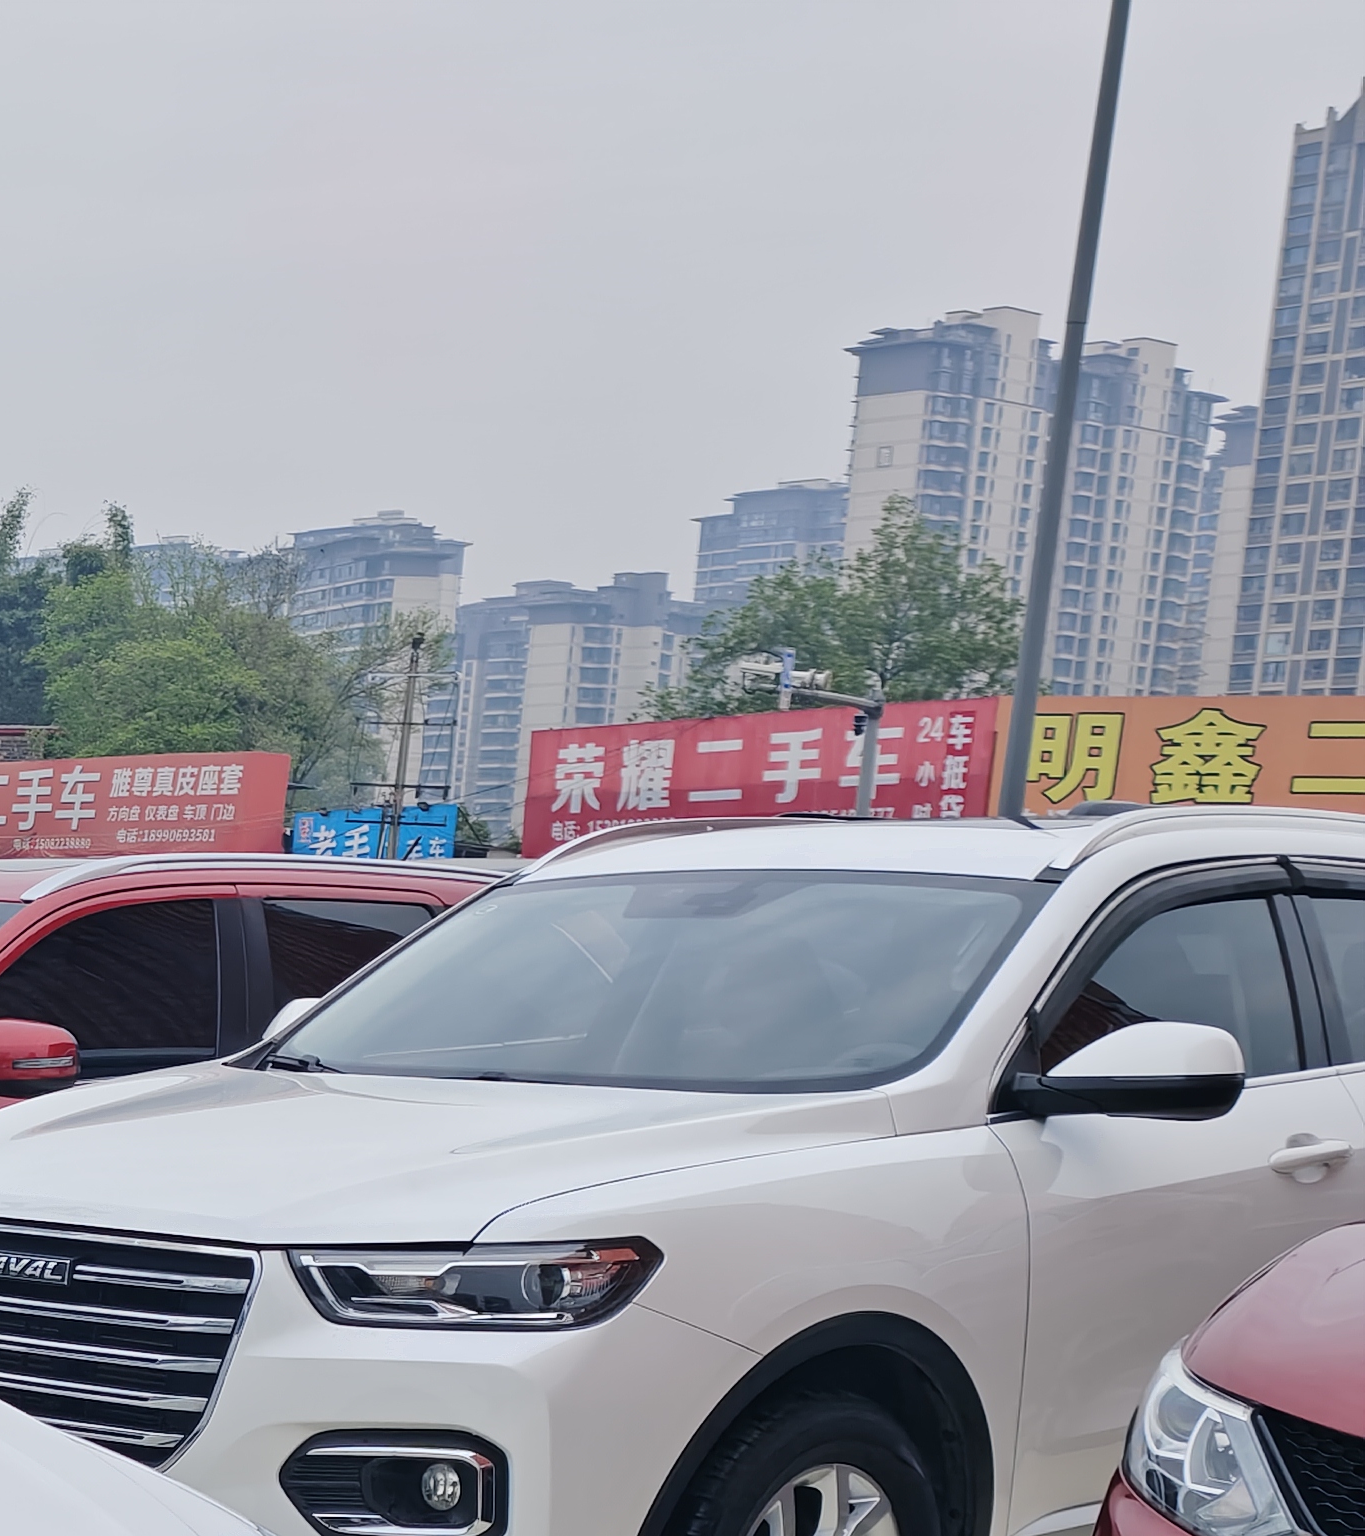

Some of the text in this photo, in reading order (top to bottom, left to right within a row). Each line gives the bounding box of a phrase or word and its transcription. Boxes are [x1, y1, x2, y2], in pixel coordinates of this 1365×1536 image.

[109, 764, 245, 798] 雅尊真皮座套
[551, 727, 905, 814] 荣耀二手车
[106, 803, 236, 822] 方向盘 仪表盘 车顶 门边
